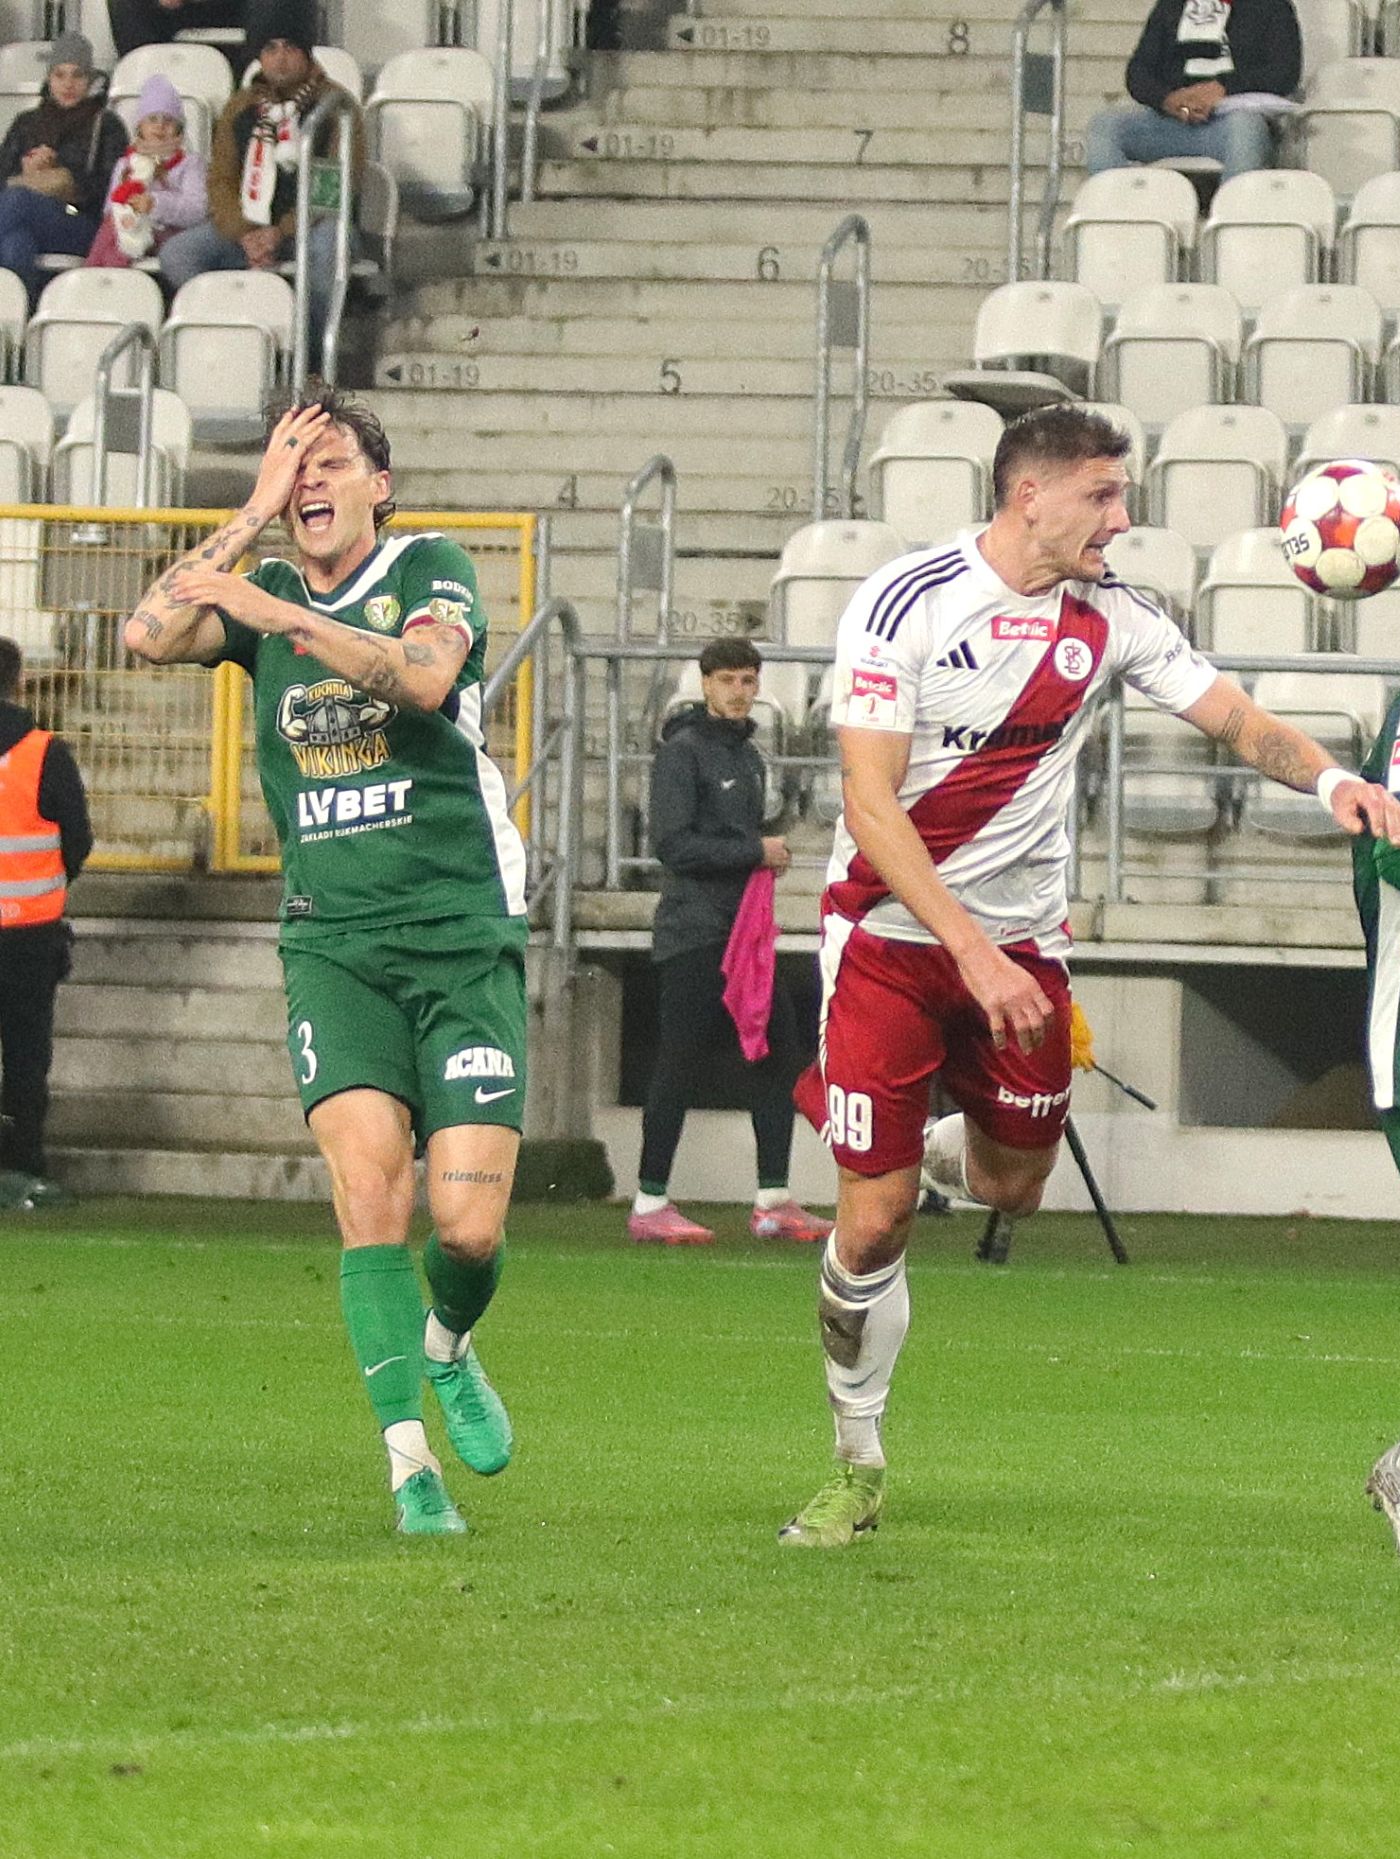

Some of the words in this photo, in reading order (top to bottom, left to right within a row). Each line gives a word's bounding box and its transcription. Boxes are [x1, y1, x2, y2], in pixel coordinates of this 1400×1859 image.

[702, 26, 770, 49] 01-19
[949, 21, 970, 55] 8
[605, 134, 675, 157] 01-19
[854, 129, 874, 165] 7
[508, 250, 578, 273] 01-19
[757, 247, 780, 282] 6
[409, 363, 480, 387] 01-19
[660, 359, 682, 395] 5
[557, 474, 579, 508] 4
[767, 486, 840, 509] 20-5
[998, 620, 1049, 637] Betlic
[290, 730, 391, 778] VIKINGA
[297, 1020, 318, 1085] 3
[444, 1046, 516, 1081] ACANA
[829, 1083, 873, 1152] 99
